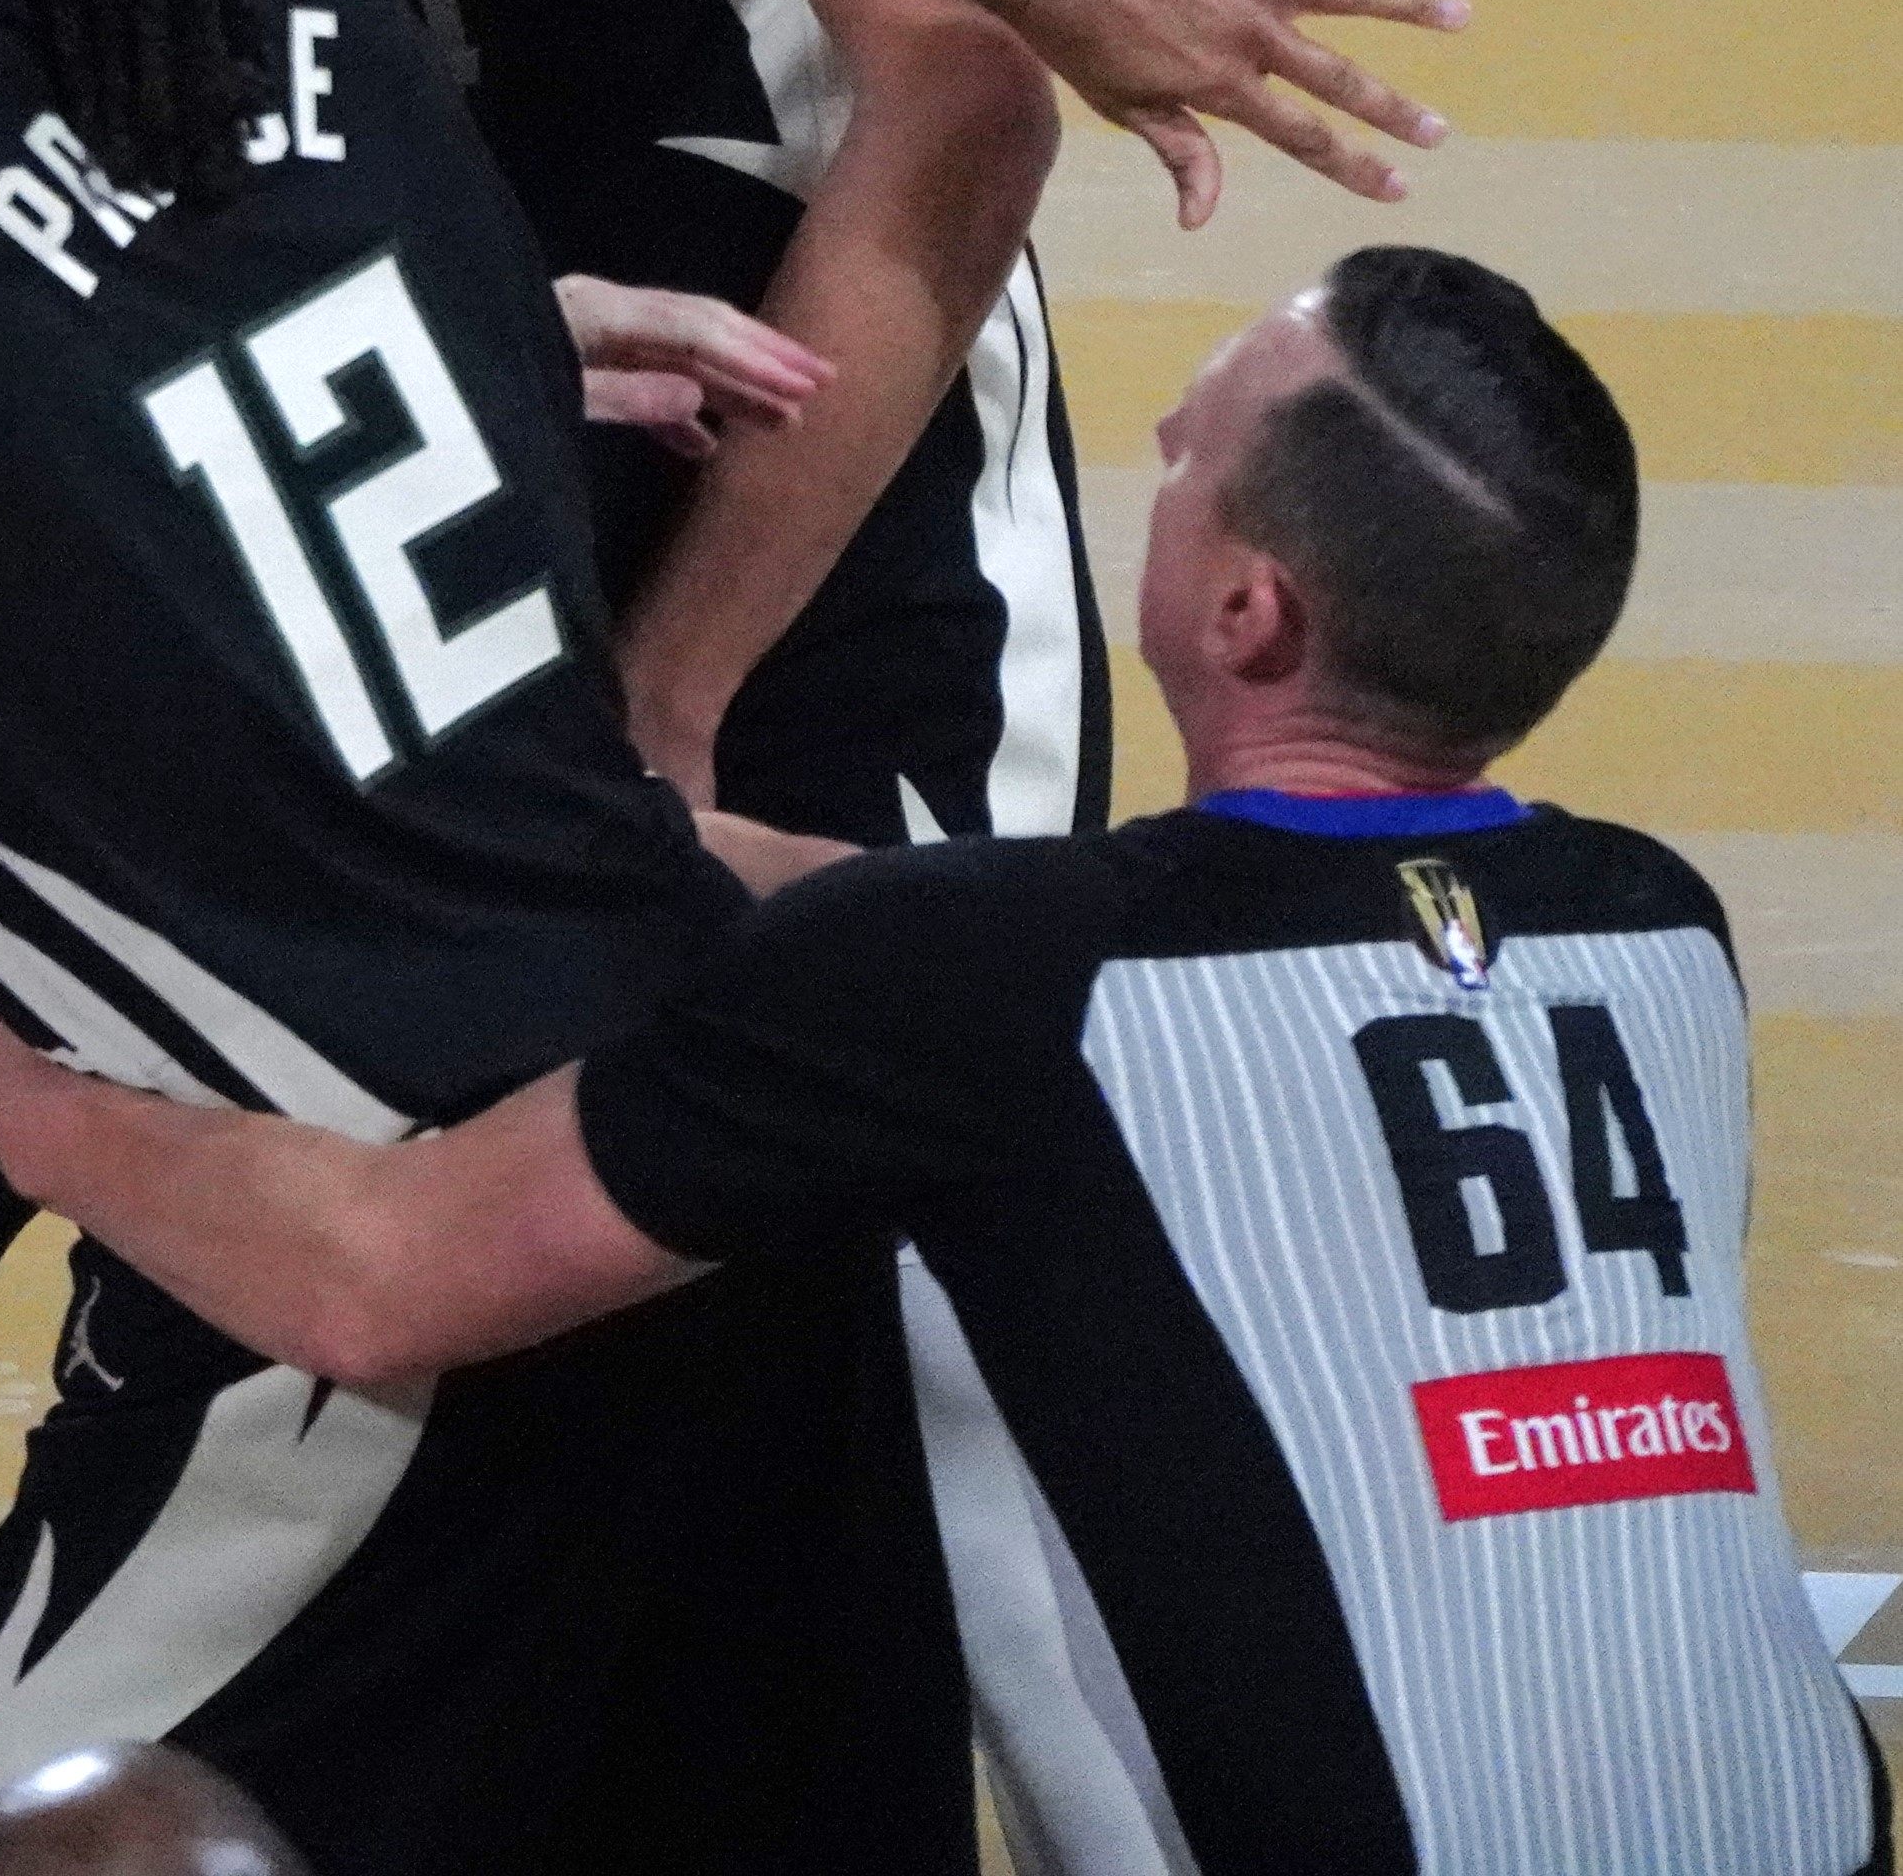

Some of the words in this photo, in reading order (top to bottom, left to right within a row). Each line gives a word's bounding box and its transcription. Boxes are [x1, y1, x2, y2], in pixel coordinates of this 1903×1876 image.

[143, 254, 563, 783] 12
[1352, 1004, 1692, 1316] 64
[1458, 1394, 1733, 1477] Emirates
